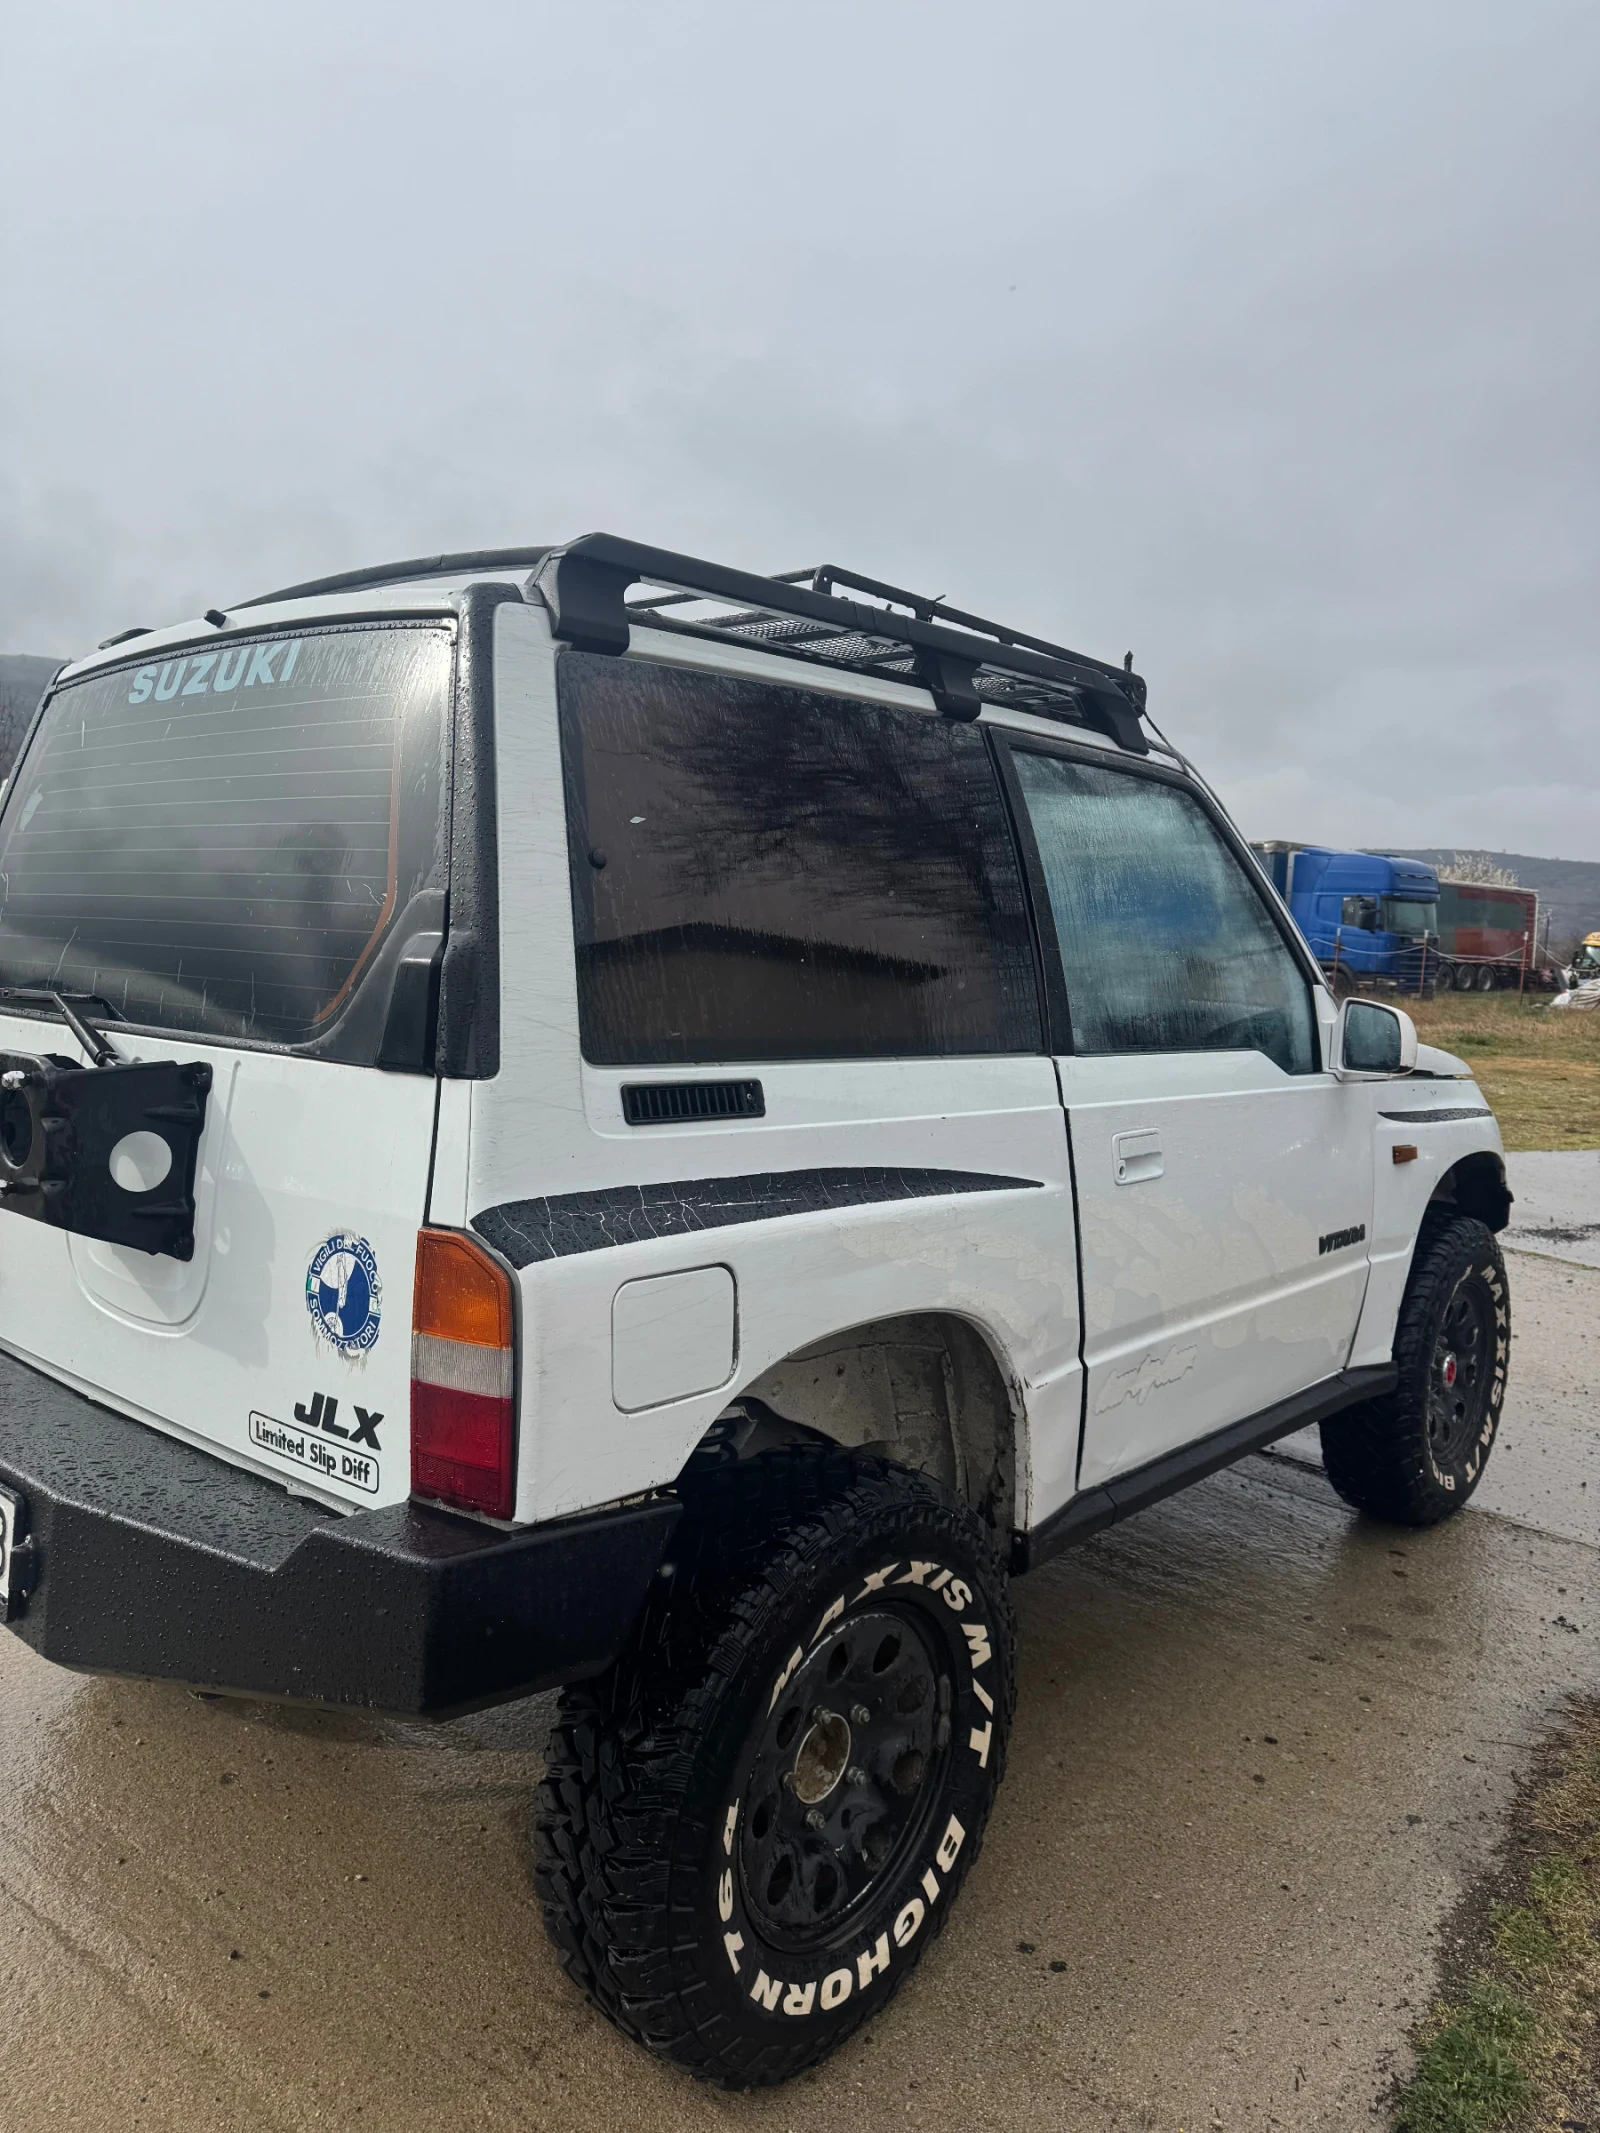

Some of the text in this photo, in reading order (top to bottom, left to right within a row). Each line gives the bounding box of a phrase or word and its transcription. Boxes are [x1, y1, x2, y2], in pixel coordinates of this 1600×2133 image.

[128, 640, 302, 704] SUZUKI
[312, 1243, 336, 1272] VIGILI
[355, 1244, 379, 1292] FUOCO
[1480, 1264, 1507, 1408] MAXXIS
[255, 1420, 371, 1484] Limited Slip Diff
[293, 1391, 385, 1451] JLX
[766, 1560, 974, 1719] MAXXIS
[960, 1623, 995, 1770] M/T
[749, 1813, 966, 2016] BIGHORN
